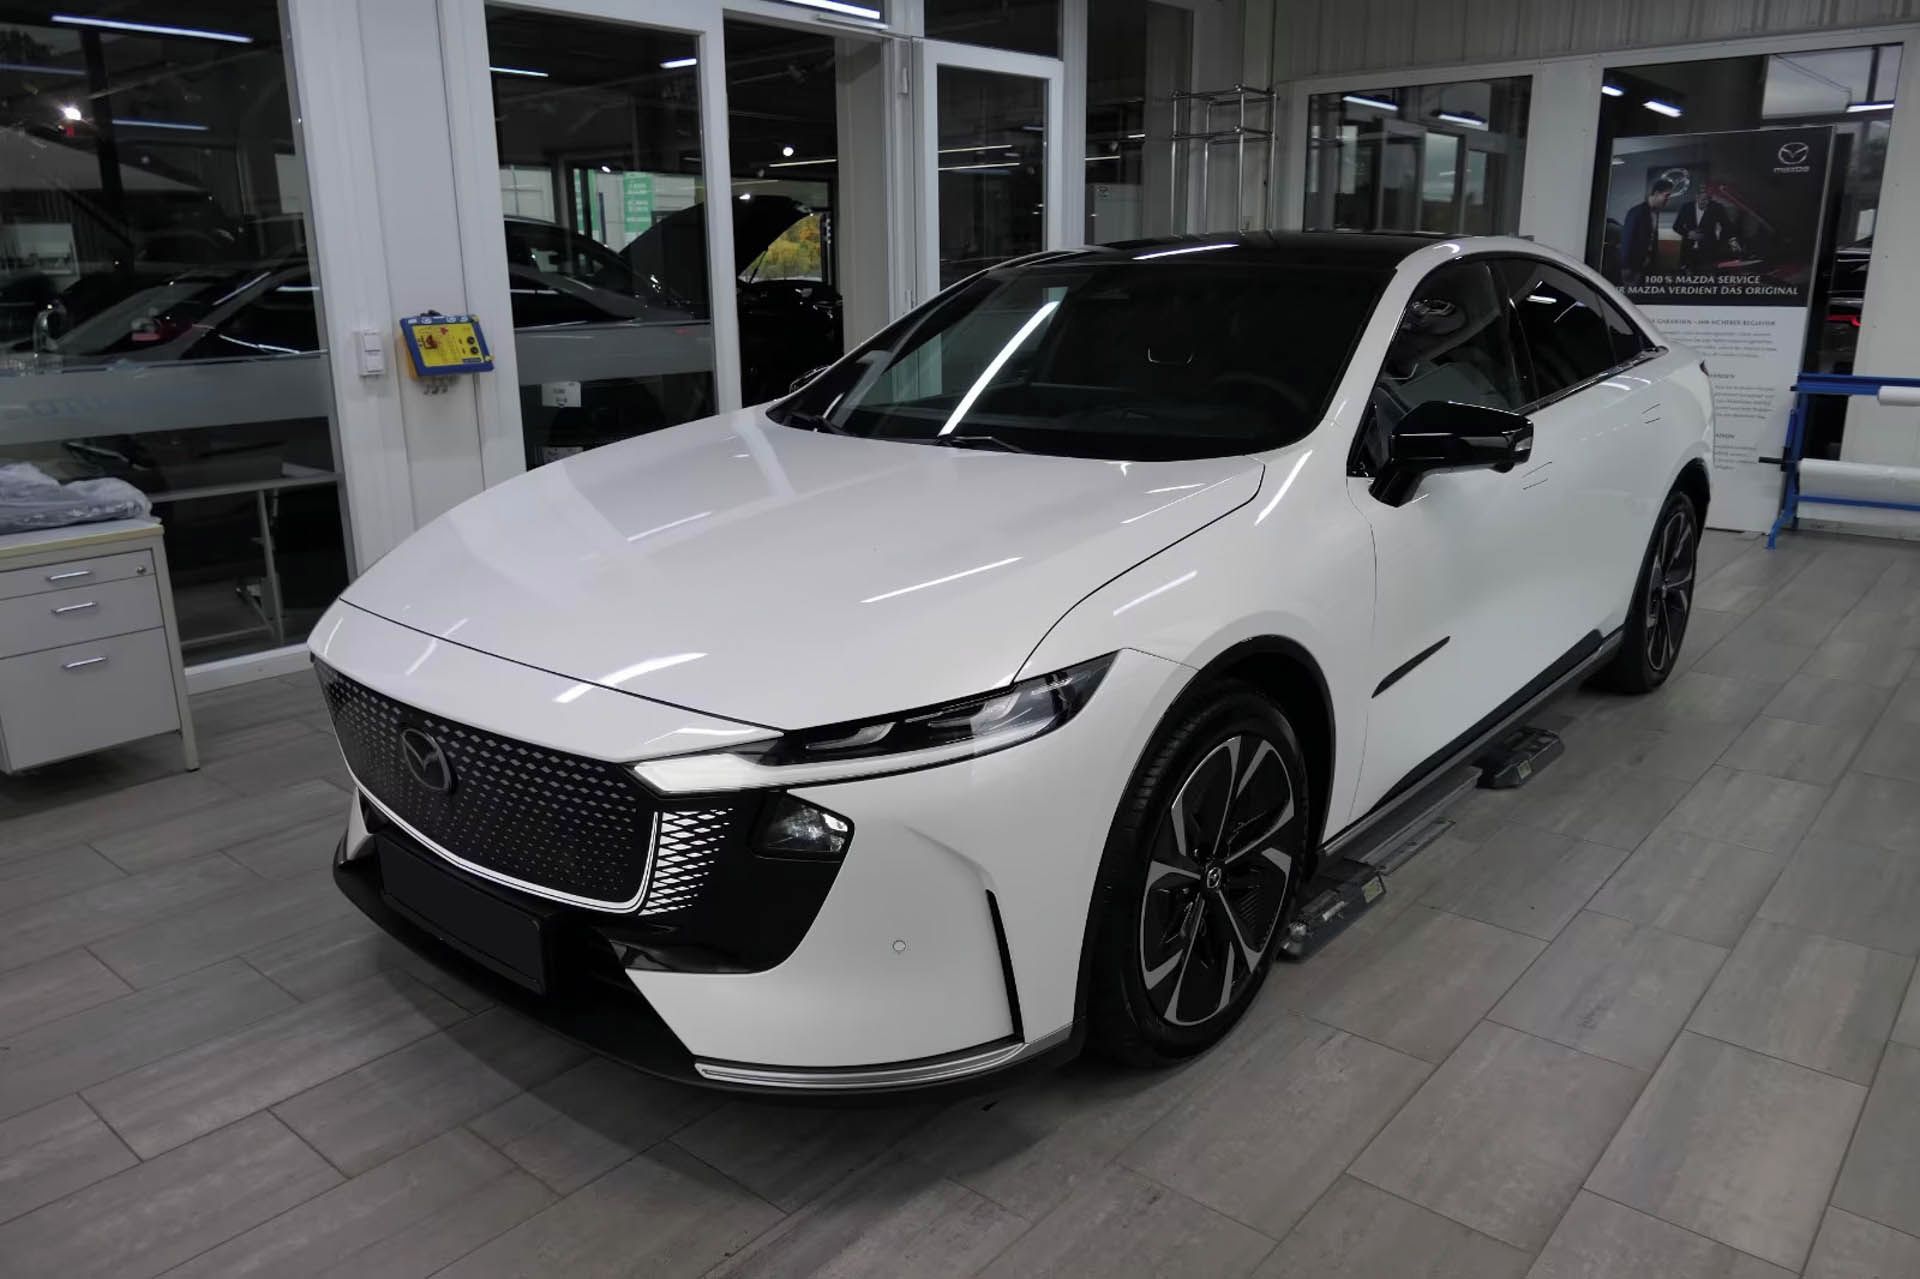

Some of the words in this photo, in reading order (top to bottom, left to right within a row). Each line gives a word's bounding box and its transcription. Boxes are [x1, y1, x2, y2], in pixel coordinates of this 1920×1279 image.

[1645, 275, 1663, 284] 100
[1675, 275, 1715, 284] MAZDA
[1718, 275, 1761, 284] SERVICE
[1627, 286, 1666, 294] MAZDA
[1668, 286, 1718, 295] VERDIENT
[1720, 286, 1742, 295] DAS
[1745, 286, 1799, 295] ORIGINAL
